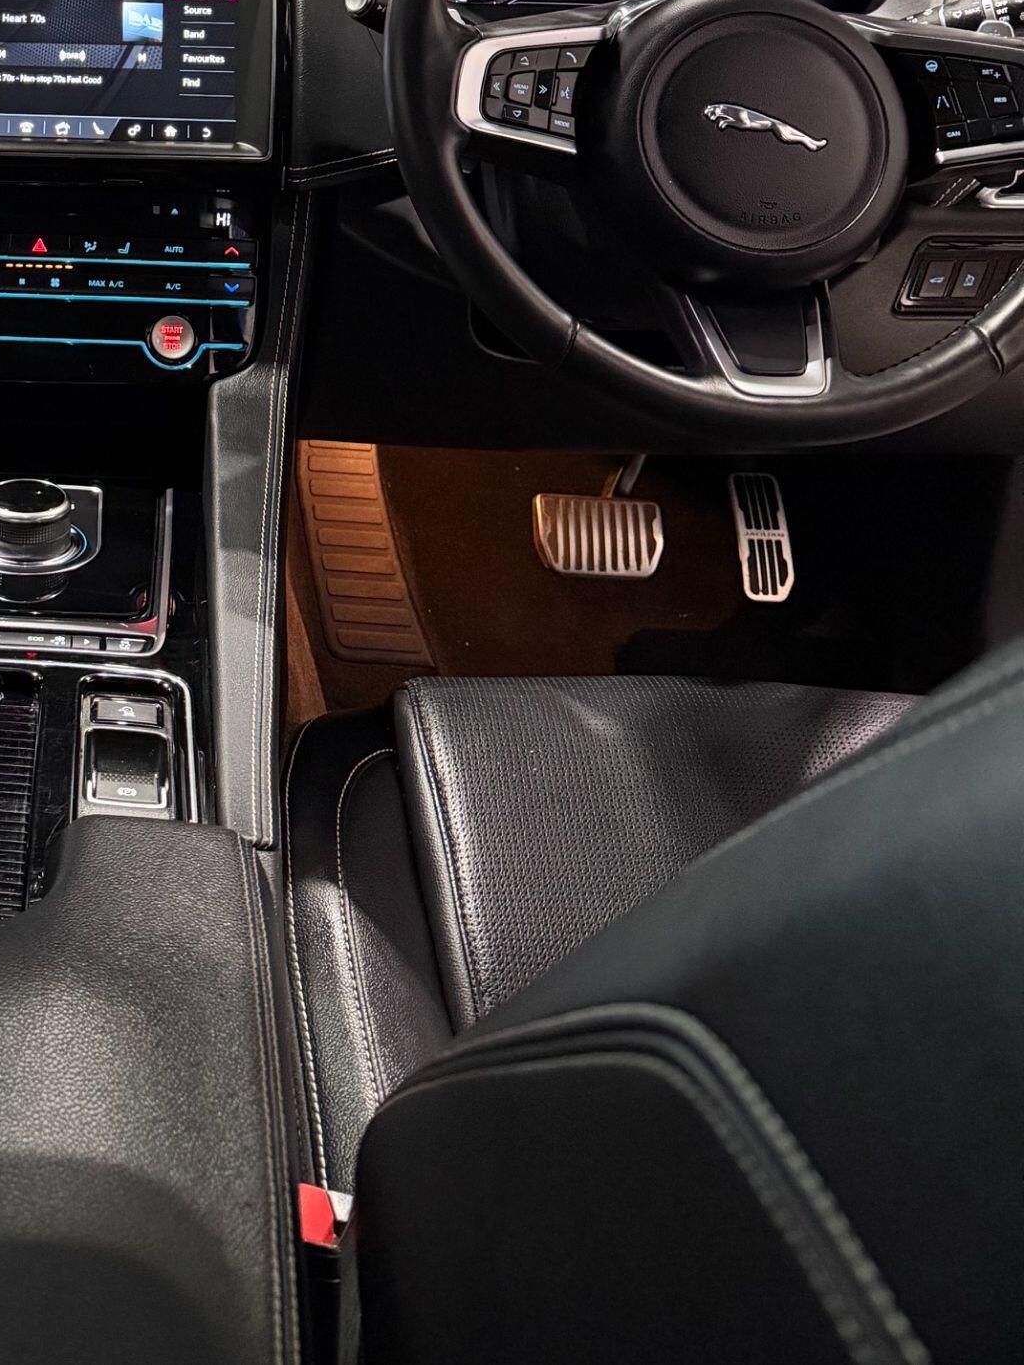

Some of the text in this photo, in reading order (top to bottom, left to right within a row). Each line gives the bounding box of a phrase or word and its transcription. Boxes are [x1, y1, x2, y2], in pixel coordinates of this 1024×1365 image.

[183, 5, 213, 15] Source
[2, 13, 46, 24] Heart 70s
[183, 29, 206, 39] Band
[182, 53, 226, 64] Favourites
[2, 74, 16, 83] 70s
[20, 74, 53, 85] Non-stop
[53, 75, 66, 83] 70s
[66, 75, 82, 84] Feel
[82, 76, 102, 85] Good
[182, 77, 201, 88] Find
[554, 119, 570, 128] MODE
[946, 130, 961, 138] CAN
[215, 212, 232, 226] HI
[739, 211, 802, 225] AIRBAG
[164, 245, 184, 254] AUTO
[88, 279, 124, 288] MAX A/C
[165, 282, 182, 290] A/C
[160, 325, 184, 334] START
[162, 342, 182, 351] STOP
